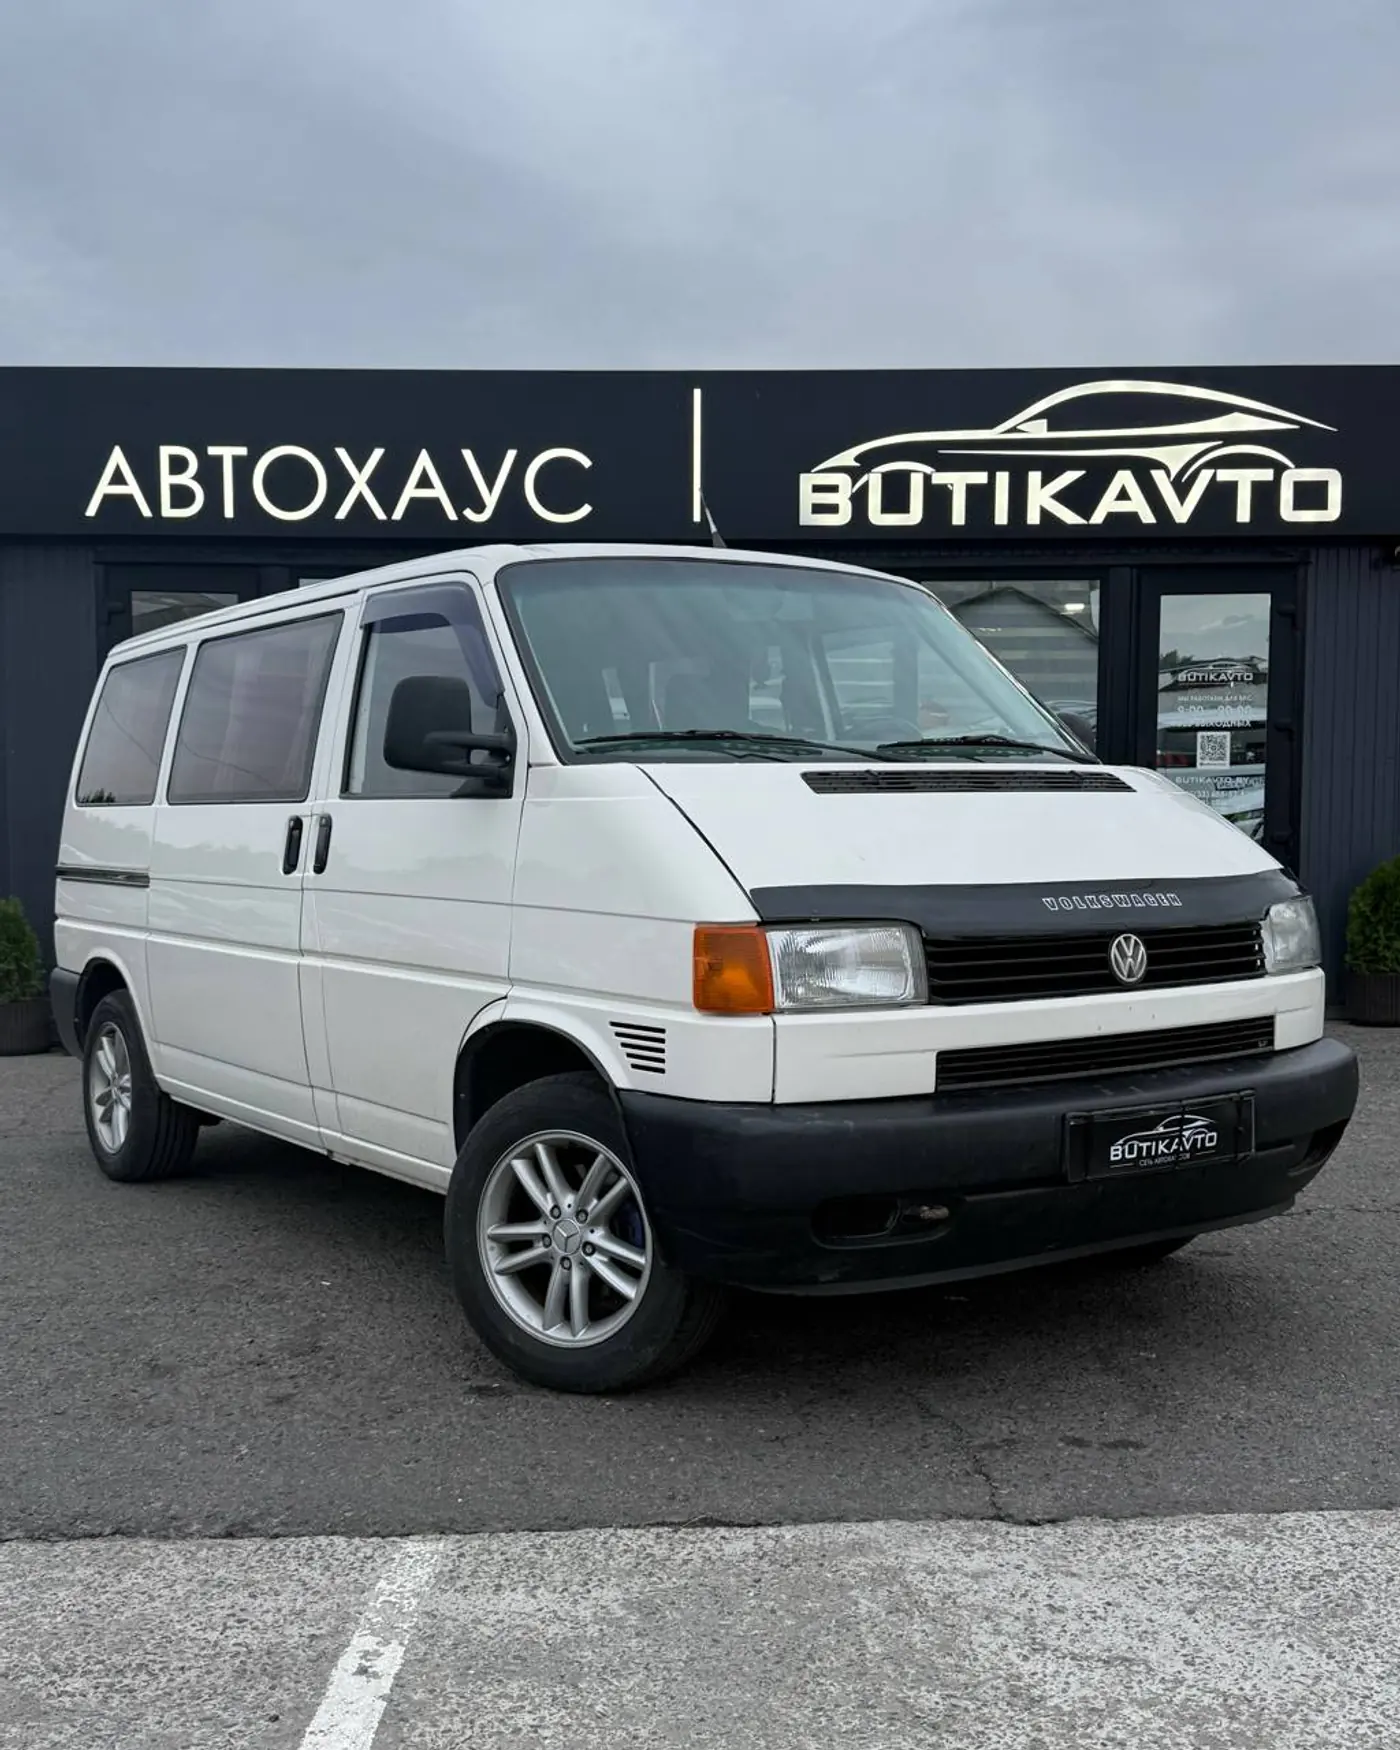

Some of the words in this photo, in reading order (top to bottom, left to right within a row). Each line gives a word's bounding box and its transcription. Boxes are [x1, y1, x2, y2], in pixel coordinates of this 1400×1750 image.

[85, 445, 593, 523] АВТОХАУС
[799, 468, 1343, 527] BUTIKAVTO
[1178, 672, 1254, 682] BUTIKAVTO
[1042, 893, 1183, 911] VOLKSWAGEN
[1109, 1132, 1218, 1161] BUTIKAVTO
